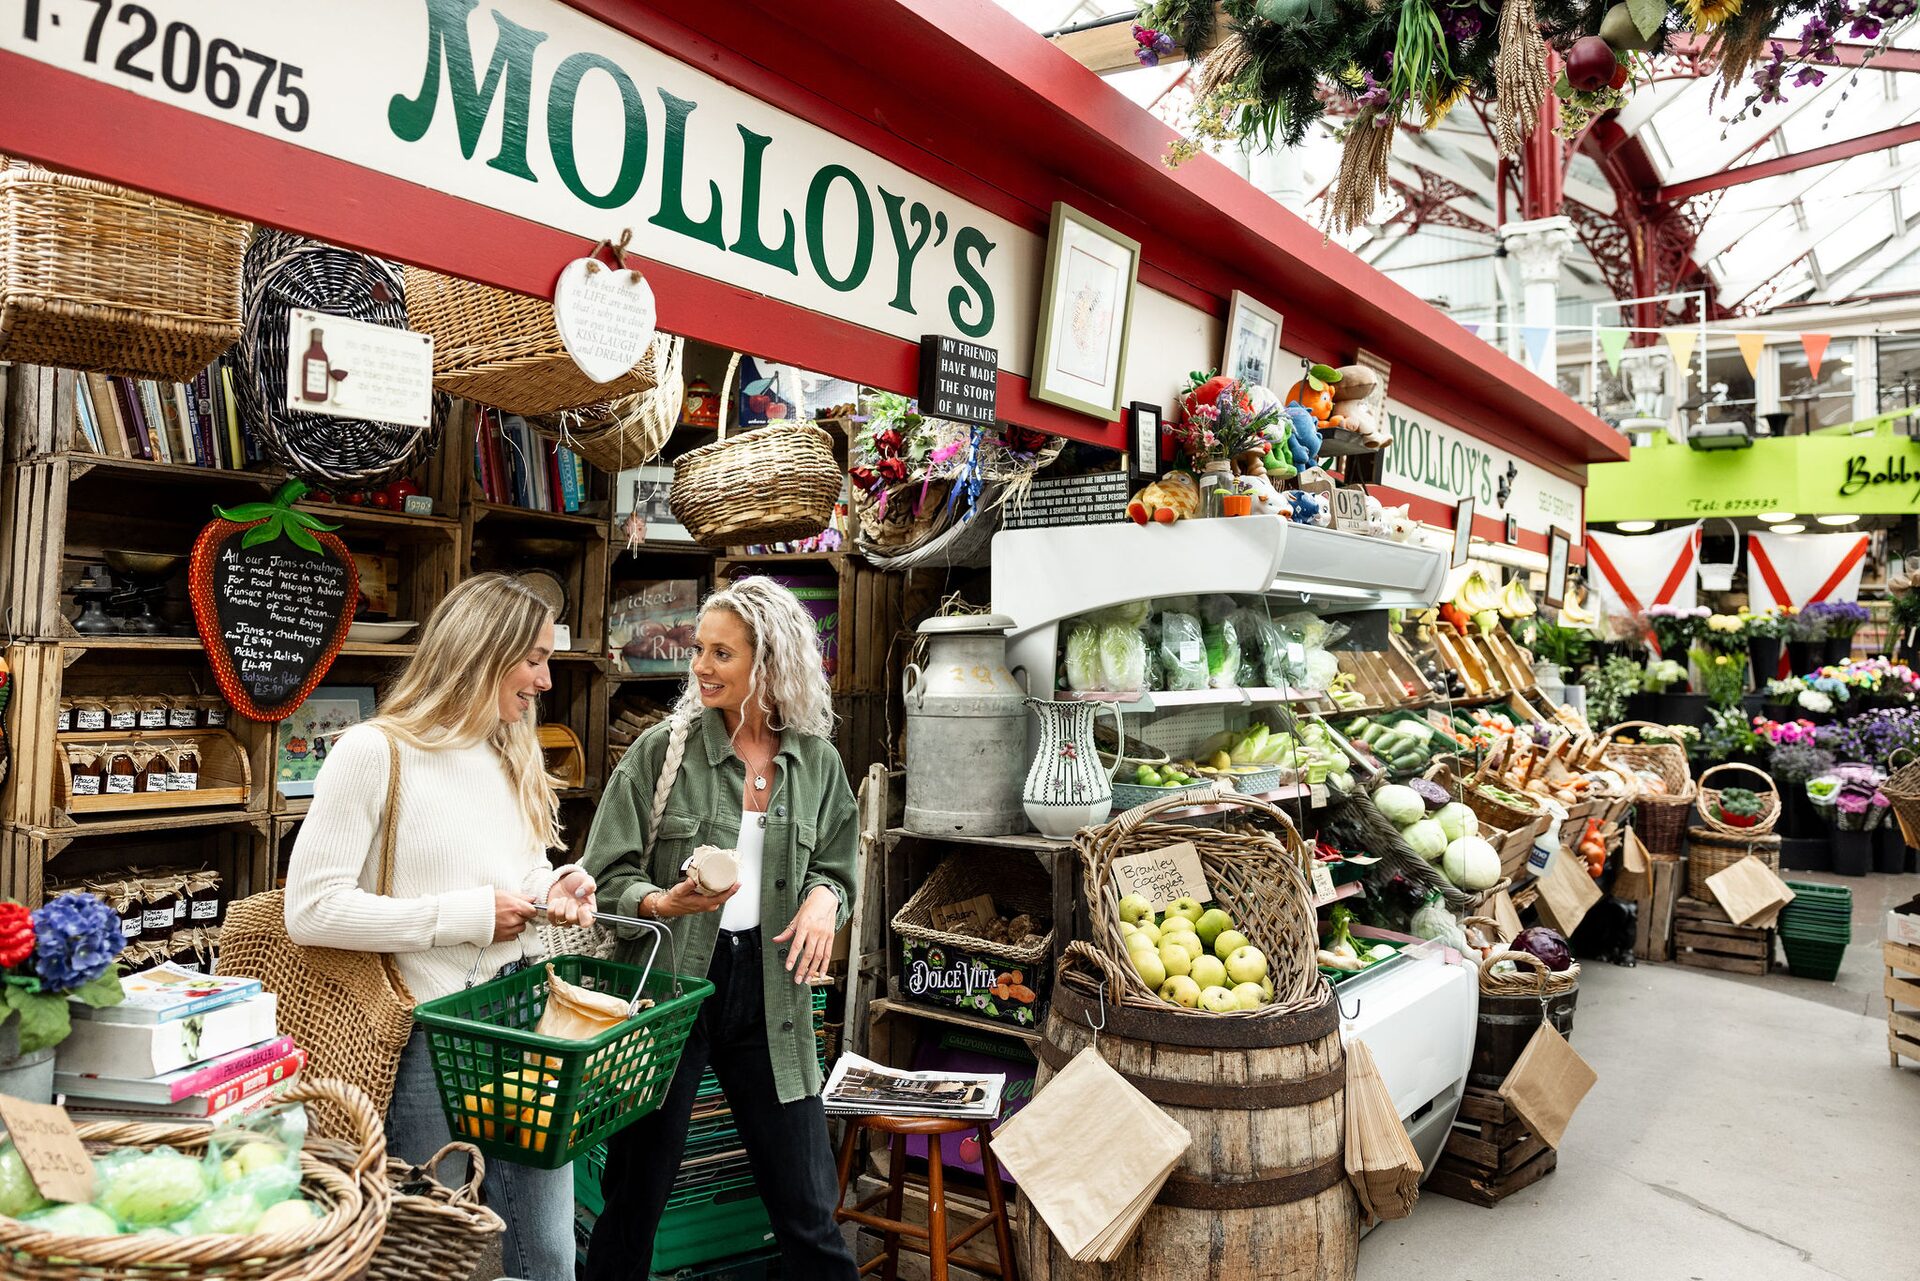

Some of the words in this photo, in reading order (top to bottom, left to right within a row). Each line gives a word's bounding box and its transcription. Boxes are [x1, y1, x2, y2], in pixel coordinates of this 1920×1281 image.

[387, 0, 997, 338] MOLLOY'S
[584, 289, 607, 306] LIFE
[616, 285, 641, 302] things
[600, 334, 637, 353] LAUGH
[942, 338, 956, 353] MY
[958, 343, 997, 364] FRIENDS
[576, 344, 595, 355] and
[595, 346, 633, 366] DREAM
[941, 358, 967, 377] HAVE
[970, 365, 996, 384] MADE
[940, 378, 960, 396] THE
[963, 384, 995, 402] STORY
[939, 399, 952, 413] OF
[955, 402, 970, 417] MY
[973, 406, 994, 422] LIFE
[1386, 412, 1492, 506] MOLLOY'S
[1086, 476, 1094, 484] ARE
[1094, 475, 1107, 484] THOSE
[1107, 474, 1117, 483] WHO
[1117, 473, 1127, 482] HAVE
[1095, 494, 1108, 502] THESE
[1108, 493, 1127, 501] PERSONS
[1101, 484, 1116, 493] KNOWN
[1078, 504, 1087, 512] AND
[1337, 491, 1362, 517] 03
[1114, 511, 1123, 519] AND
[222, 548, 239, 564] All
[245, 556, 263, 565] our
[270, 555, 297, 568] Jams
[227, 575, 244, 584] For
[251, 578, 273, 588] Food
[280, 581, 313, 594] Allergen
[317, 586, 345, 597] Advice
[250, 566, 274, 578] made
[278, 570, 299, 580] here
[301, 574, 310, 582] in
[313, 575, 340, 588] shop.
[266, 591, 293, 601] please
[296, 595, 313, 605] ask
[266, 601, 280, 612] of
[283, 604, 300, 613] our
[235, 622, 265, 636] Jams
[270, 612, 296, 624] Please
[299, 617, 324, 633] Enjoy
[224, 631, 241, 640] from
[233, 646, 264, 660] Pickles
[273, 650, 304, 664] Relish
[1120, 858, 1177, 879] Bramley
[1152, 876, 1185, 893] Apples
[908, 959, 962, 995] DOLCE
[955, 960, 998, 997] VITA
